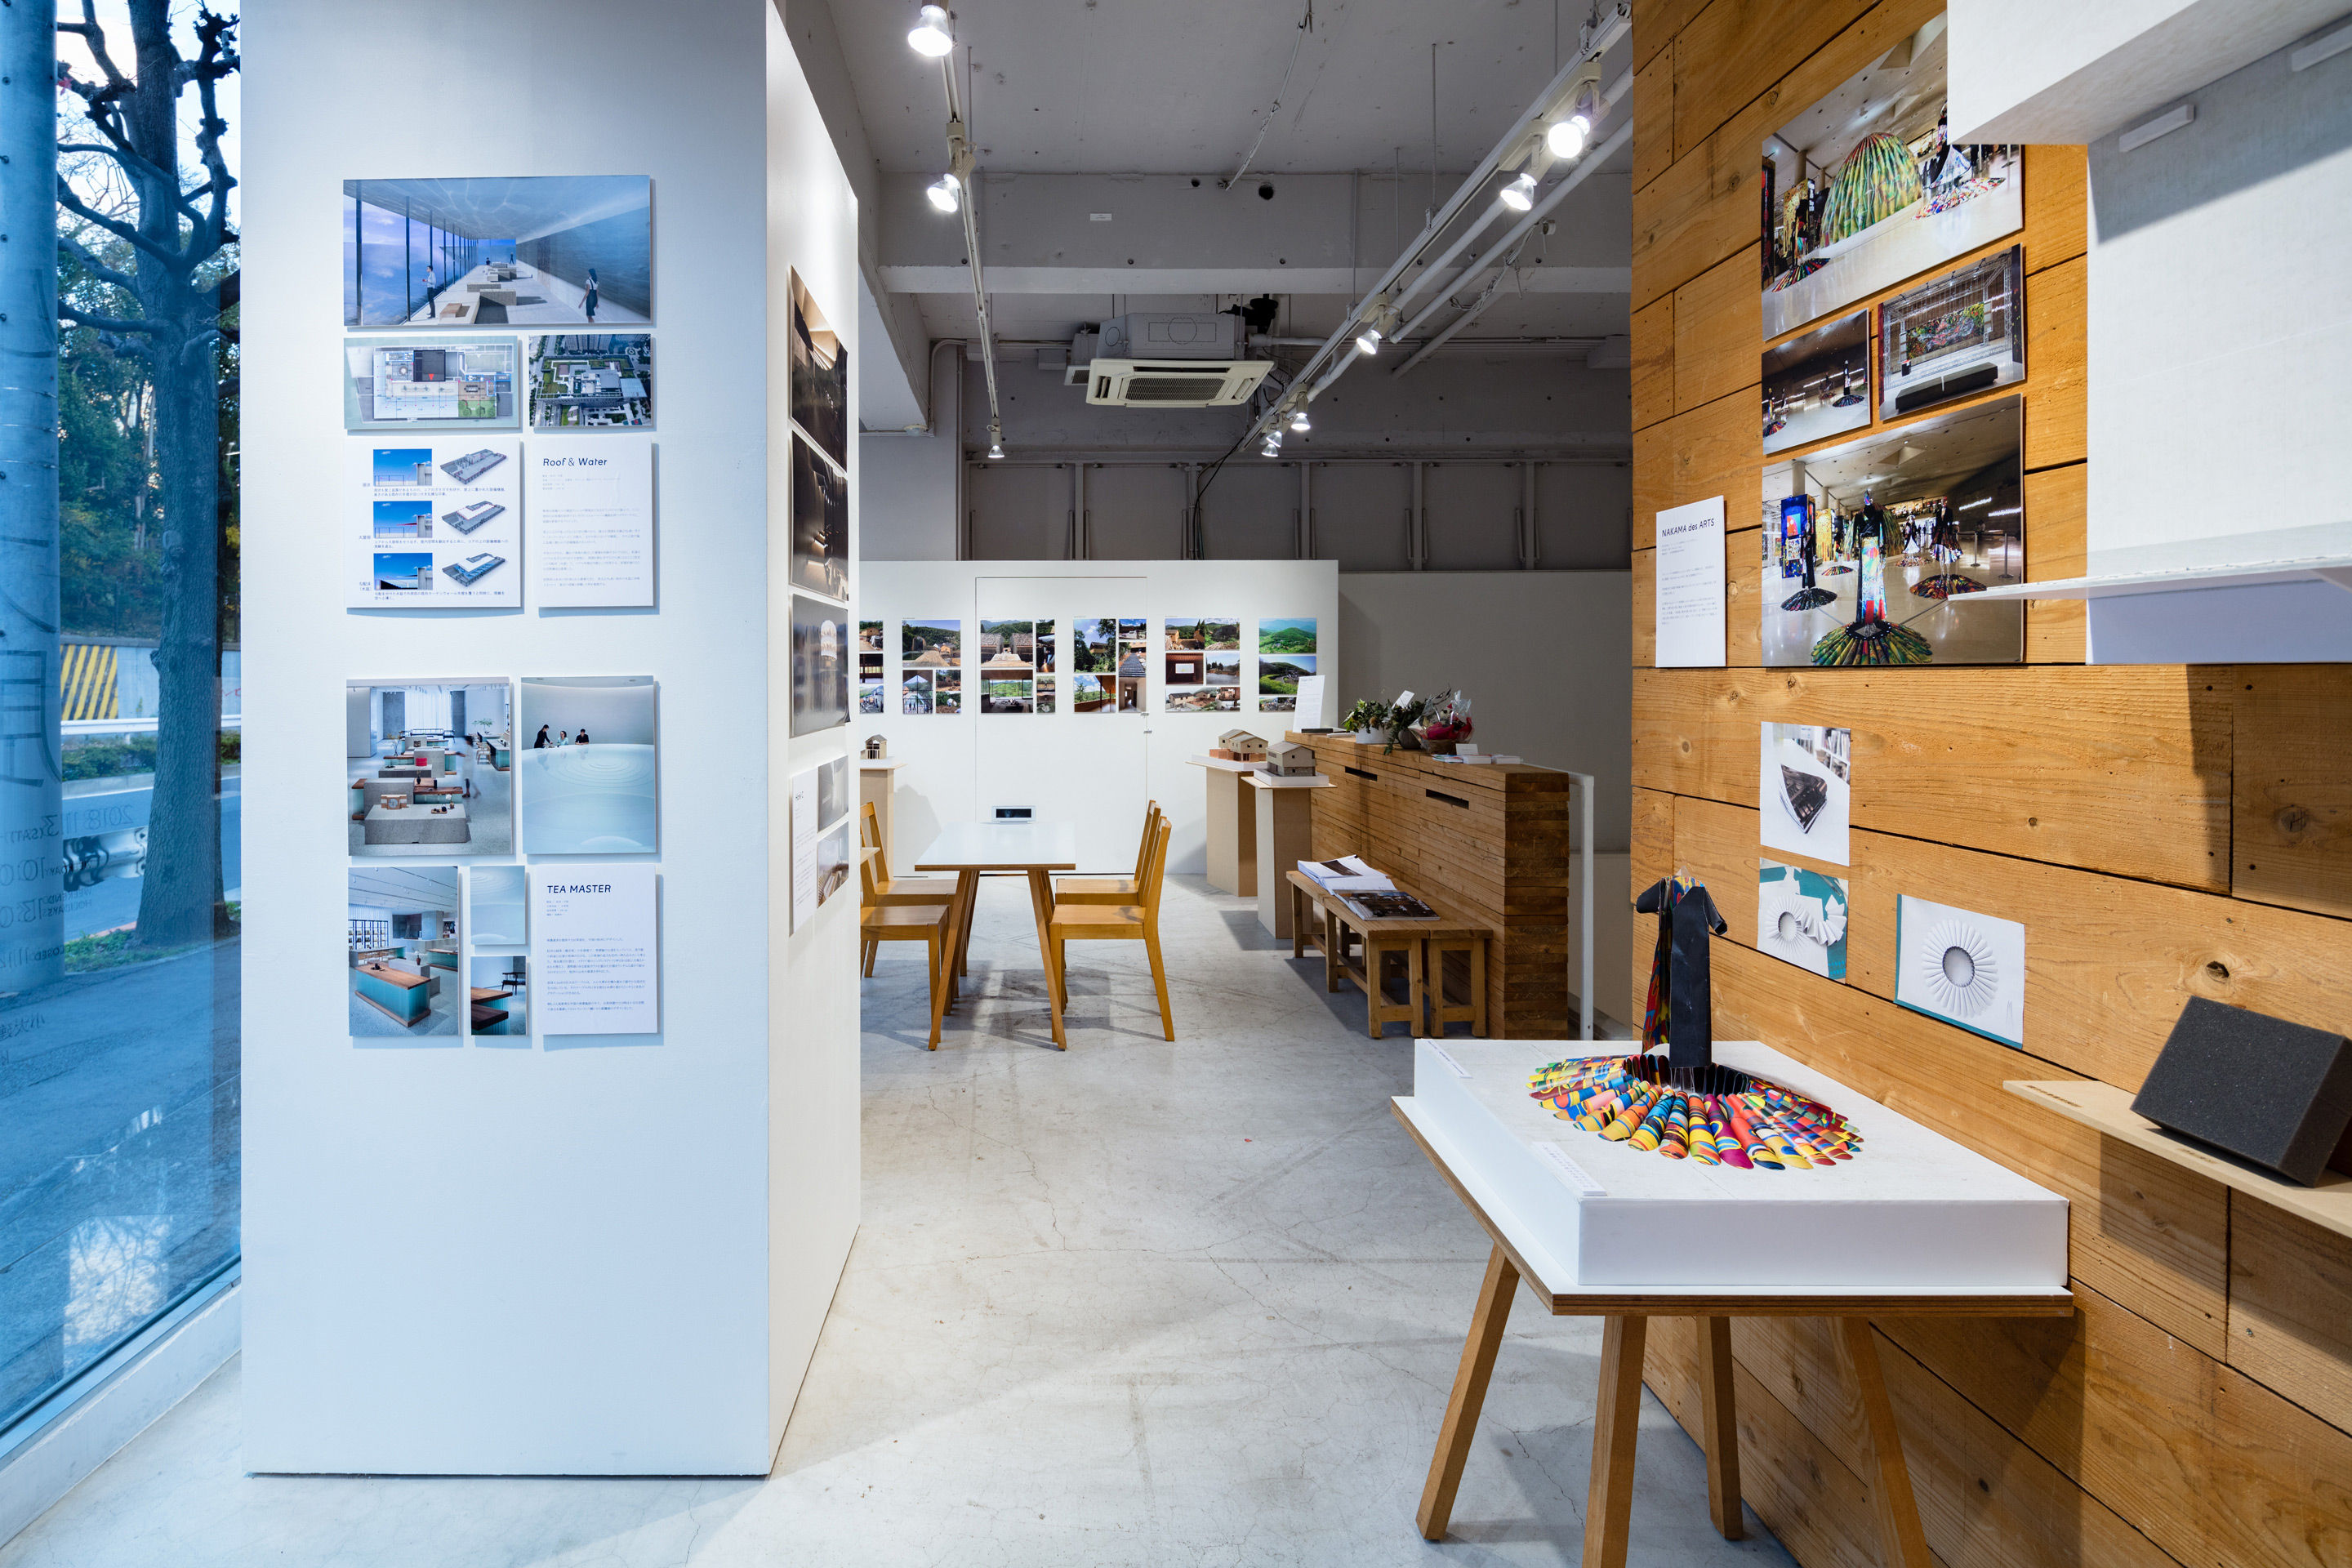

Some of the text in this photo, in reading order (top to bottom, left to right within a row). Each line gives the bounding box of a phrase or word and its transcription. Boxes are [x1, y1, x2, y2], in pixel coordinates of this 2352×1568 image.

[543, 457, 608, 466] Roof & Water
[1662, 524, 1686, 537] NAKAMA
[1699, 519, 1714, 528] ARTS
[547, 884, 611, 893] TEA MASTER
